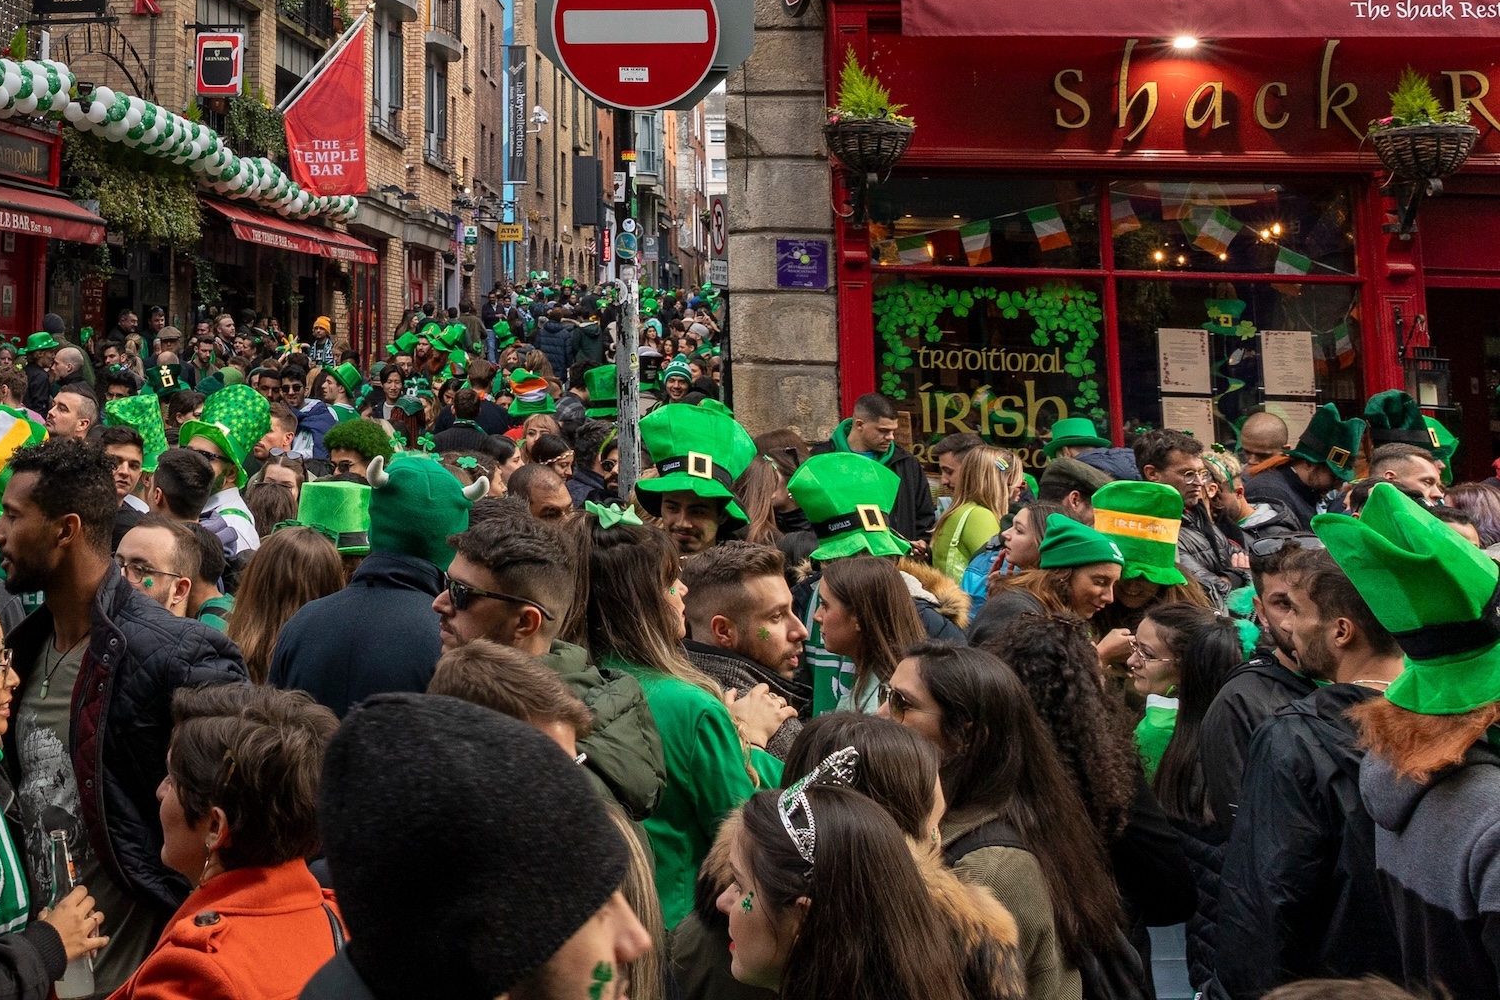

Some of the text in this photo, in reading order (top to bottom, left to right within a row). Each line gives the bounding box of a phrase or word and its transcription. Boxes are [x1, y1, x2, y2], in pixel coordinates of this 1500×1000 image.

[312, 139, 341, 150] THE
[293, 149, 359, 164] TEMPLE
[310, 164, 344, 176] BAR
[12, 213, 31, 231] BAR
